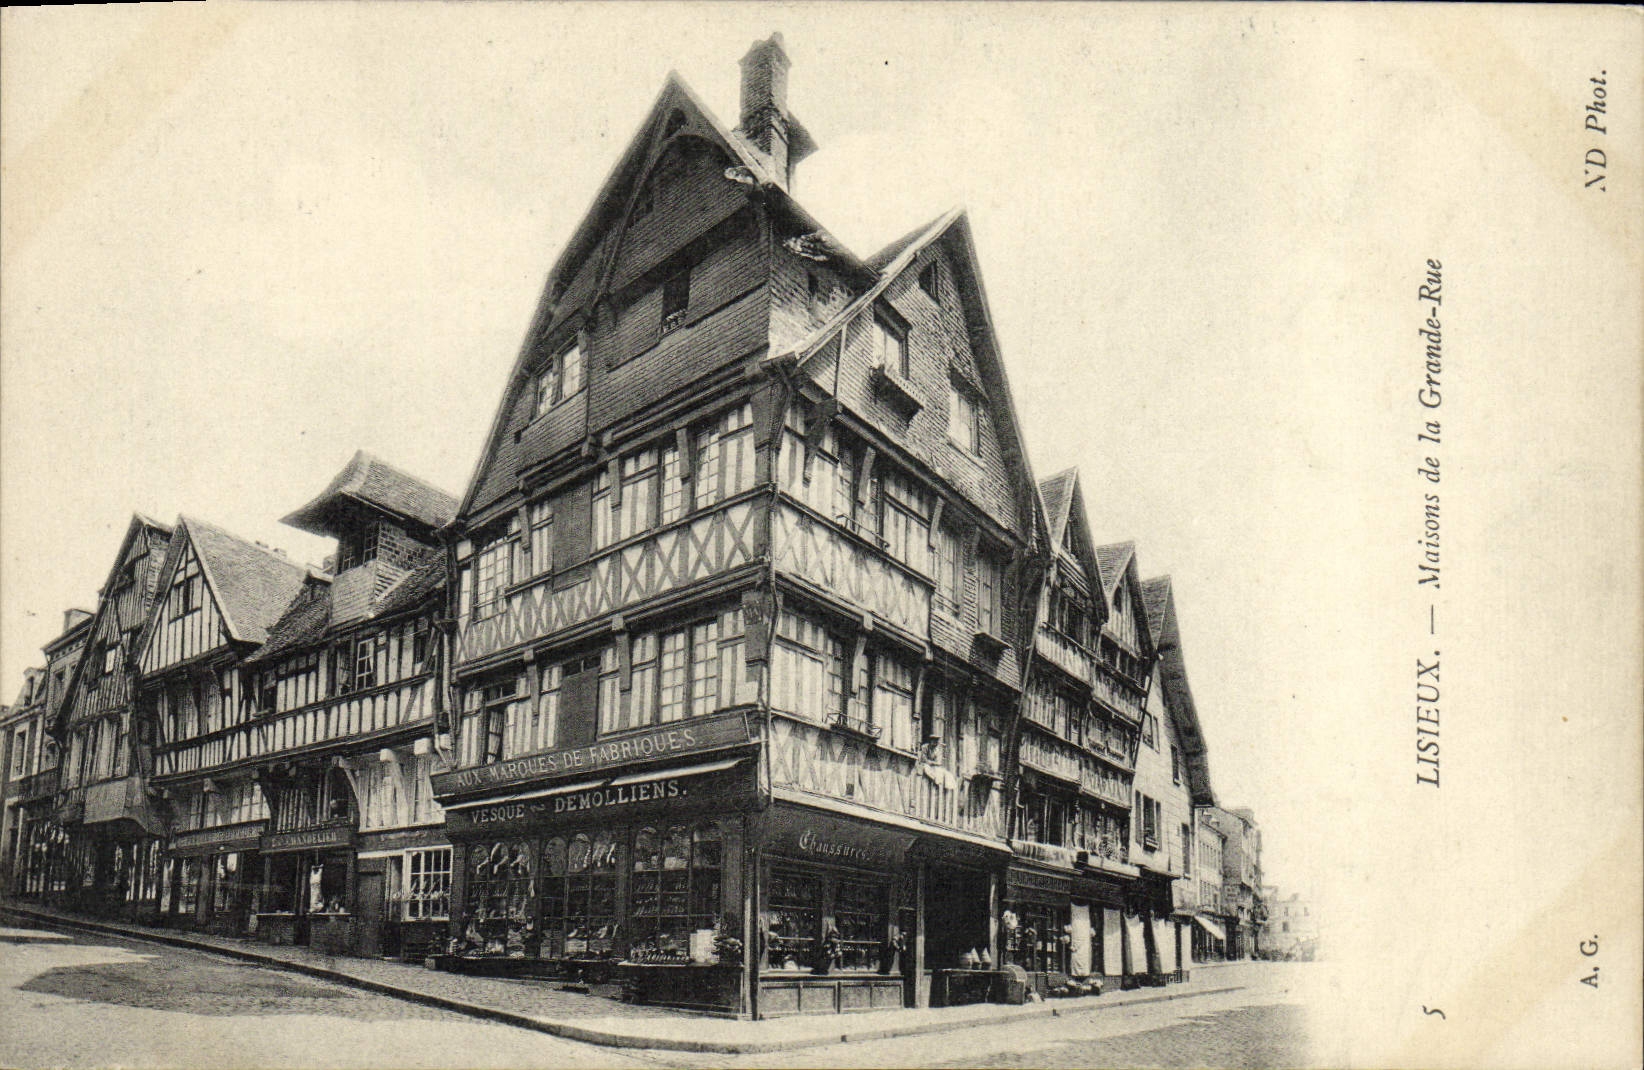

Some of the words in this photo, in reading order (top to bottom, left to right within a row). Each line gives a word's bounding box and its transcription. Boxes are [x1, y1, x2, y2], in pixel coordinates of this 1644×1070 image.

[457, 769, 482, 787] AUX
[489, 755, 557, 781] MARQUES
[562, 750, 583, 769] DE
[471, 803, 525, 824] VESQUE
